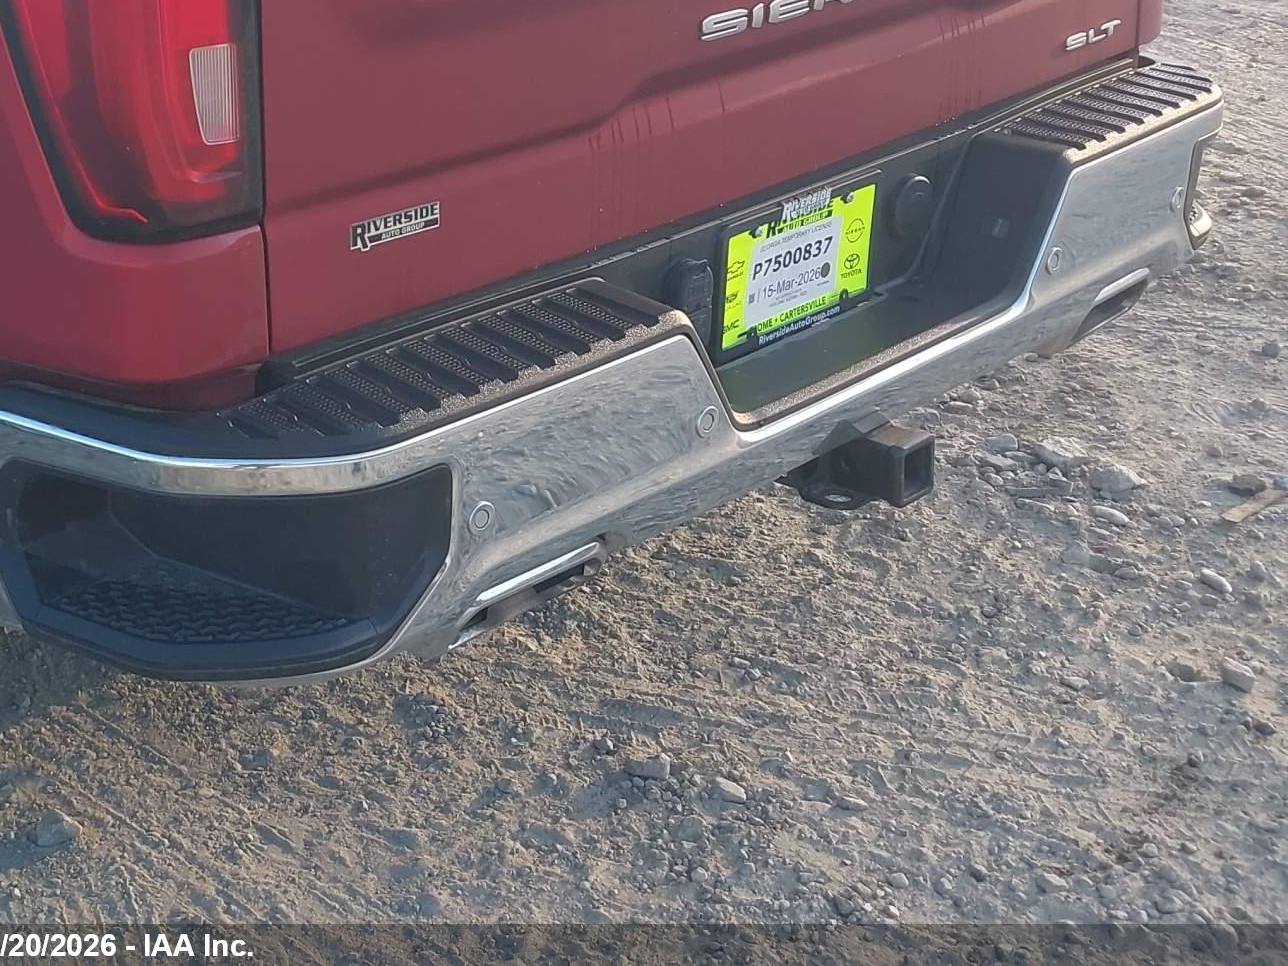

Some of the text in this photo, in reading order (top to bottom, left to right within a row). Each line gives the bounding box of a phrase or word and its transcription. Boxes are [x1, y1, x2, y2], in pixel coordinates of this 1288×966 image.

[1064, 19, 1122, 51] SLT
[351, 202, 439, 249] RIVERSIDE
[381, 221, 425, 240] AUTO GROUP
[752, 235, 833, 281] P7500837
[840, 268, 862, 280] TOYOTA
[763, 267, 822, 299] 15-Mar-2026
[755, 319, 772, 332] OME
[779, 296, 826, 322] CARTERSVILLE
[759, 305, 841, 346] RiversideAutoGroup.com
